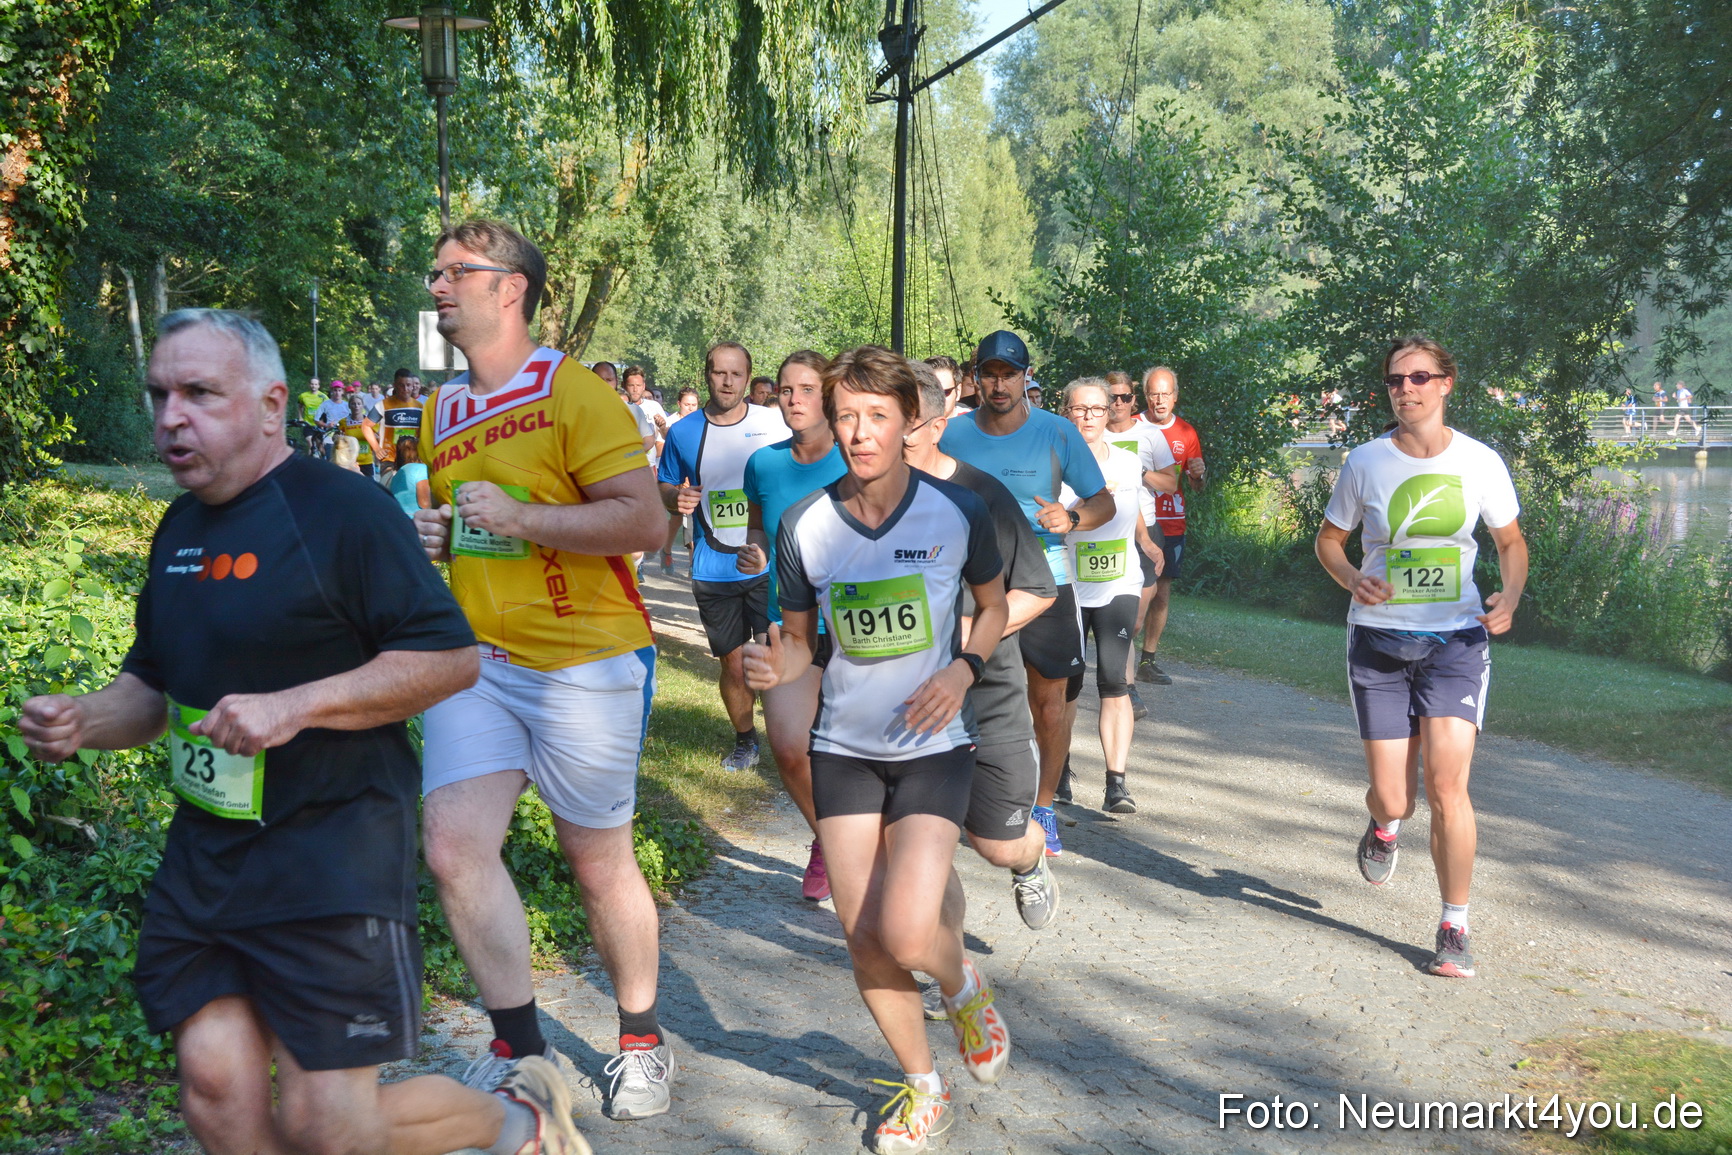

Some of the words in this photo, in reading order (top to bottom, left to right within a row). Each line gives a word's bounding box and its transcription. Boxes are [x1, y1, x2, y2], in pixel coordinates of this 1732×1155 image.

[433, 435, 478, 475] MAX
[485, 410, 554, 447] BÖGL
[716, 502, 749, 518] 210
[894, 549, 927, 559] swn
[1089, 554, 1116, 570] 991
[1403, 568, 1444, 587] 122
[843, 604, 917, 637] 1916
[852, 636, 871, 645] Barth
[872, 633, 912, 644] Christiane
[183, 742, 215, 783] 23
